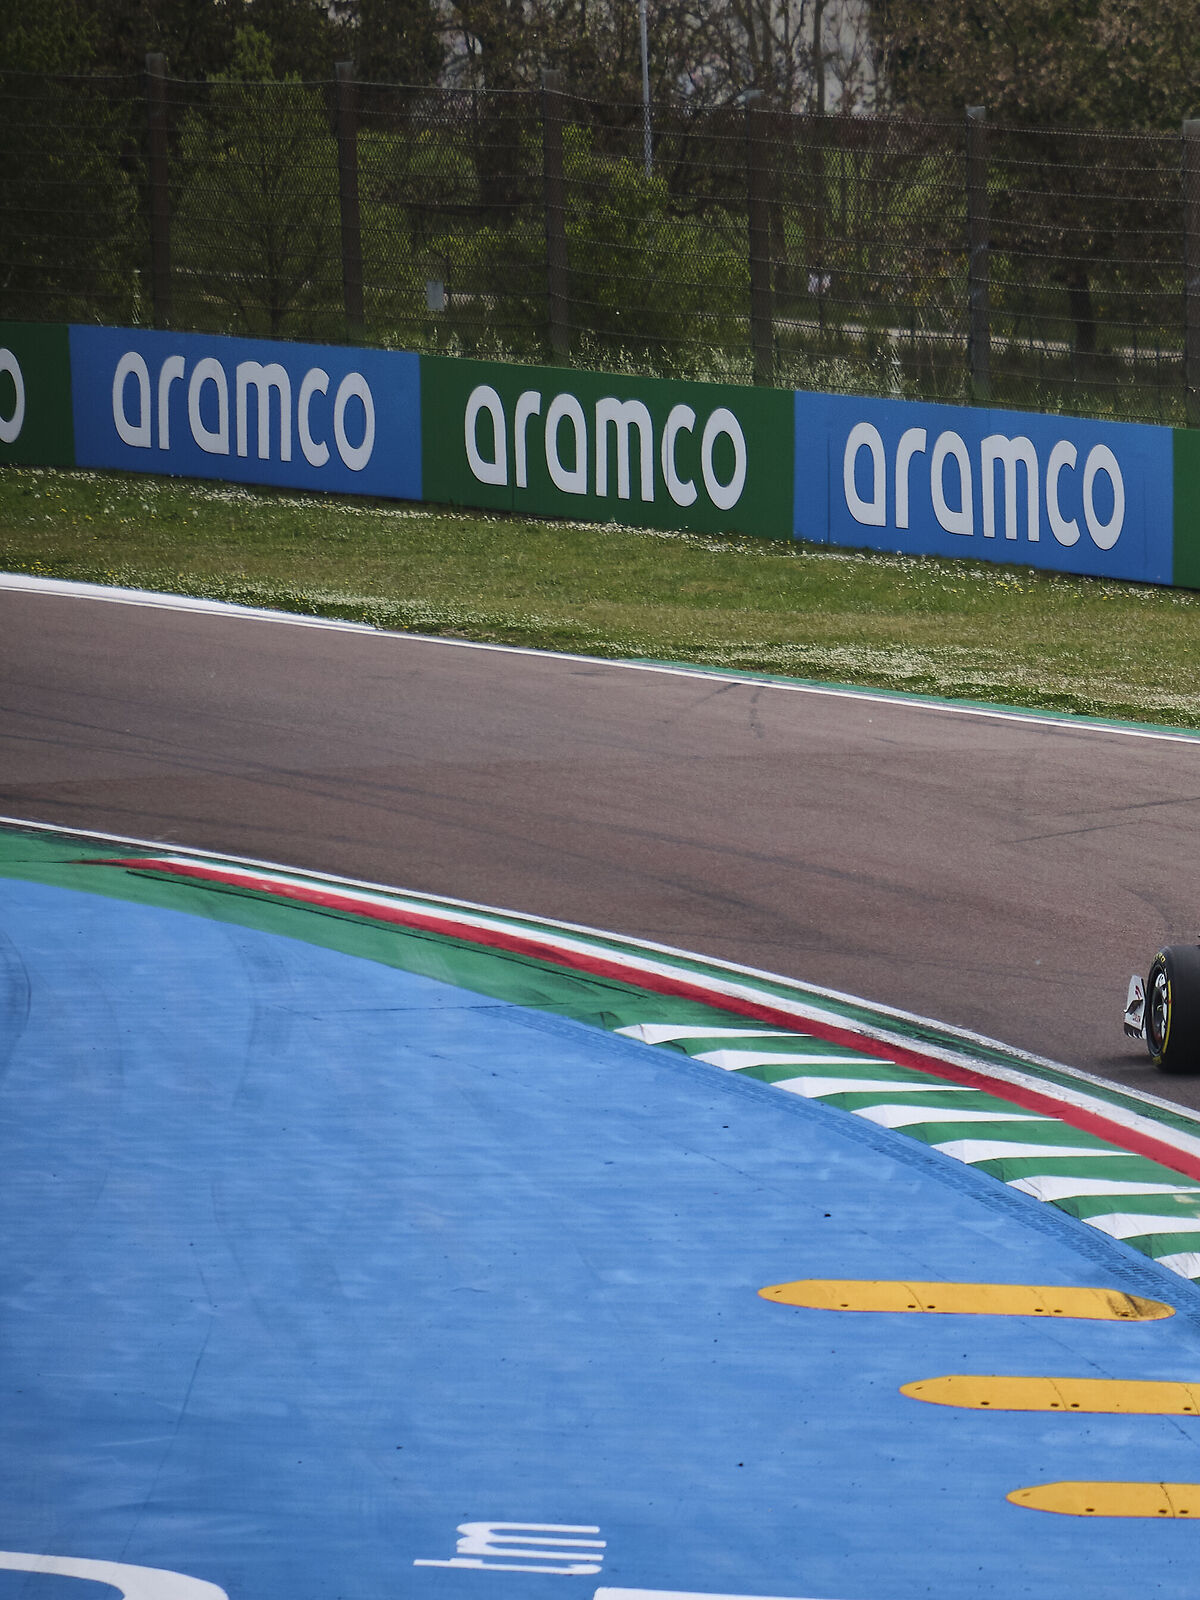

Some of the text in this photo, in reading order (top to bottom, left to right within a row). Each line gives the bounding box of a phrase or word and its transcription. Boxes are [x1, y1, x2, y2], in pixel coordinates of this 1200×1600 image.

[112, 351, 375, 471] aramco
[464, 385, 747, 510] aramco
[843, 422, 1126, 550] aramco
